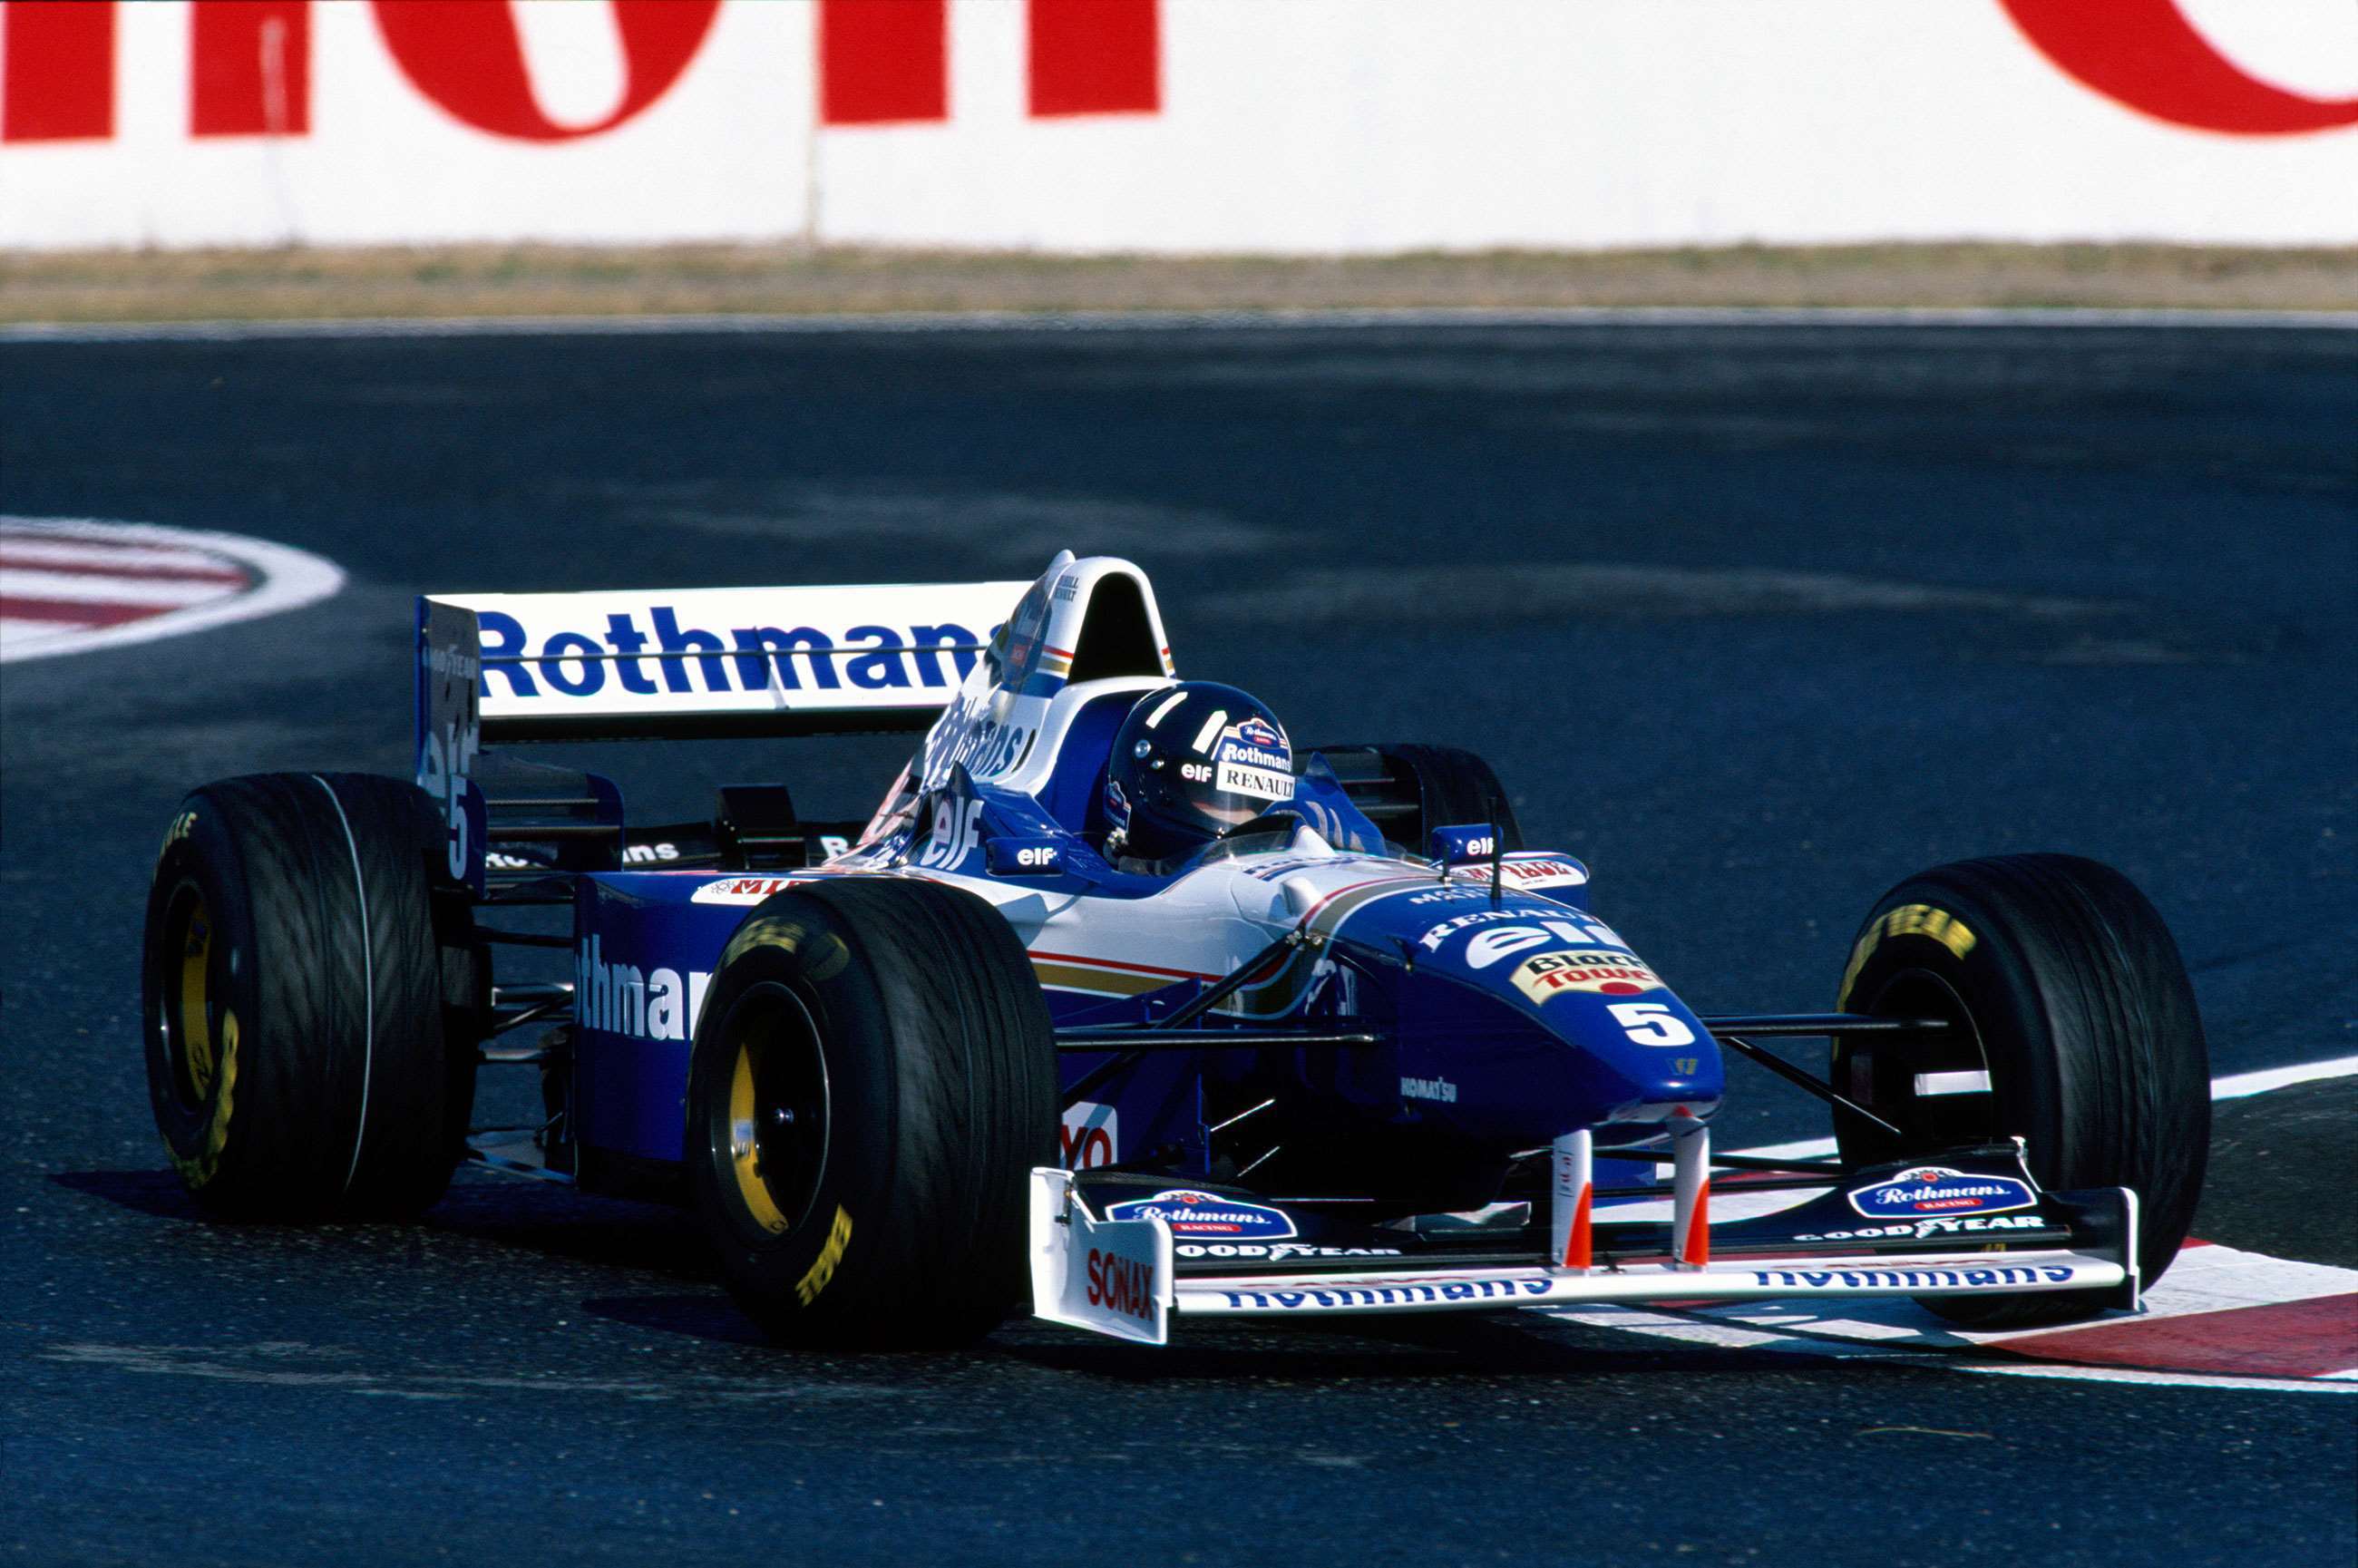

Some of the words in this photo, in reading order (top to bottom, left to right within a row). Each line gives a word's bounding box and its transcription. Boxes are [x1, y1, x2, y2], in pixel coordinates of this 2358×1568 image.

[478, 607, 1007, 696] Rothman
[1222, 743, 1291, 773] Rothmans
[1181, 764, 1213, 783] elf
[1226, 769, 1293, 798] RENAULT
[920, 796, 985, 871] elf
[1017, 847, 1055, 866] elf
[1533, 968, 1653, 989] Towe
[1606, 1003, 1695, 1047] 5
[1400, 1076, 1457, 1103] KOMATSU
[1060, 1125, 1113, 1169] YO
[1876, 1183, 2012, 1204] Rothmans
[1133, 1204, 1272, 1224] Rothmans
[1087, 1248, 1155, 1321] SONAX
